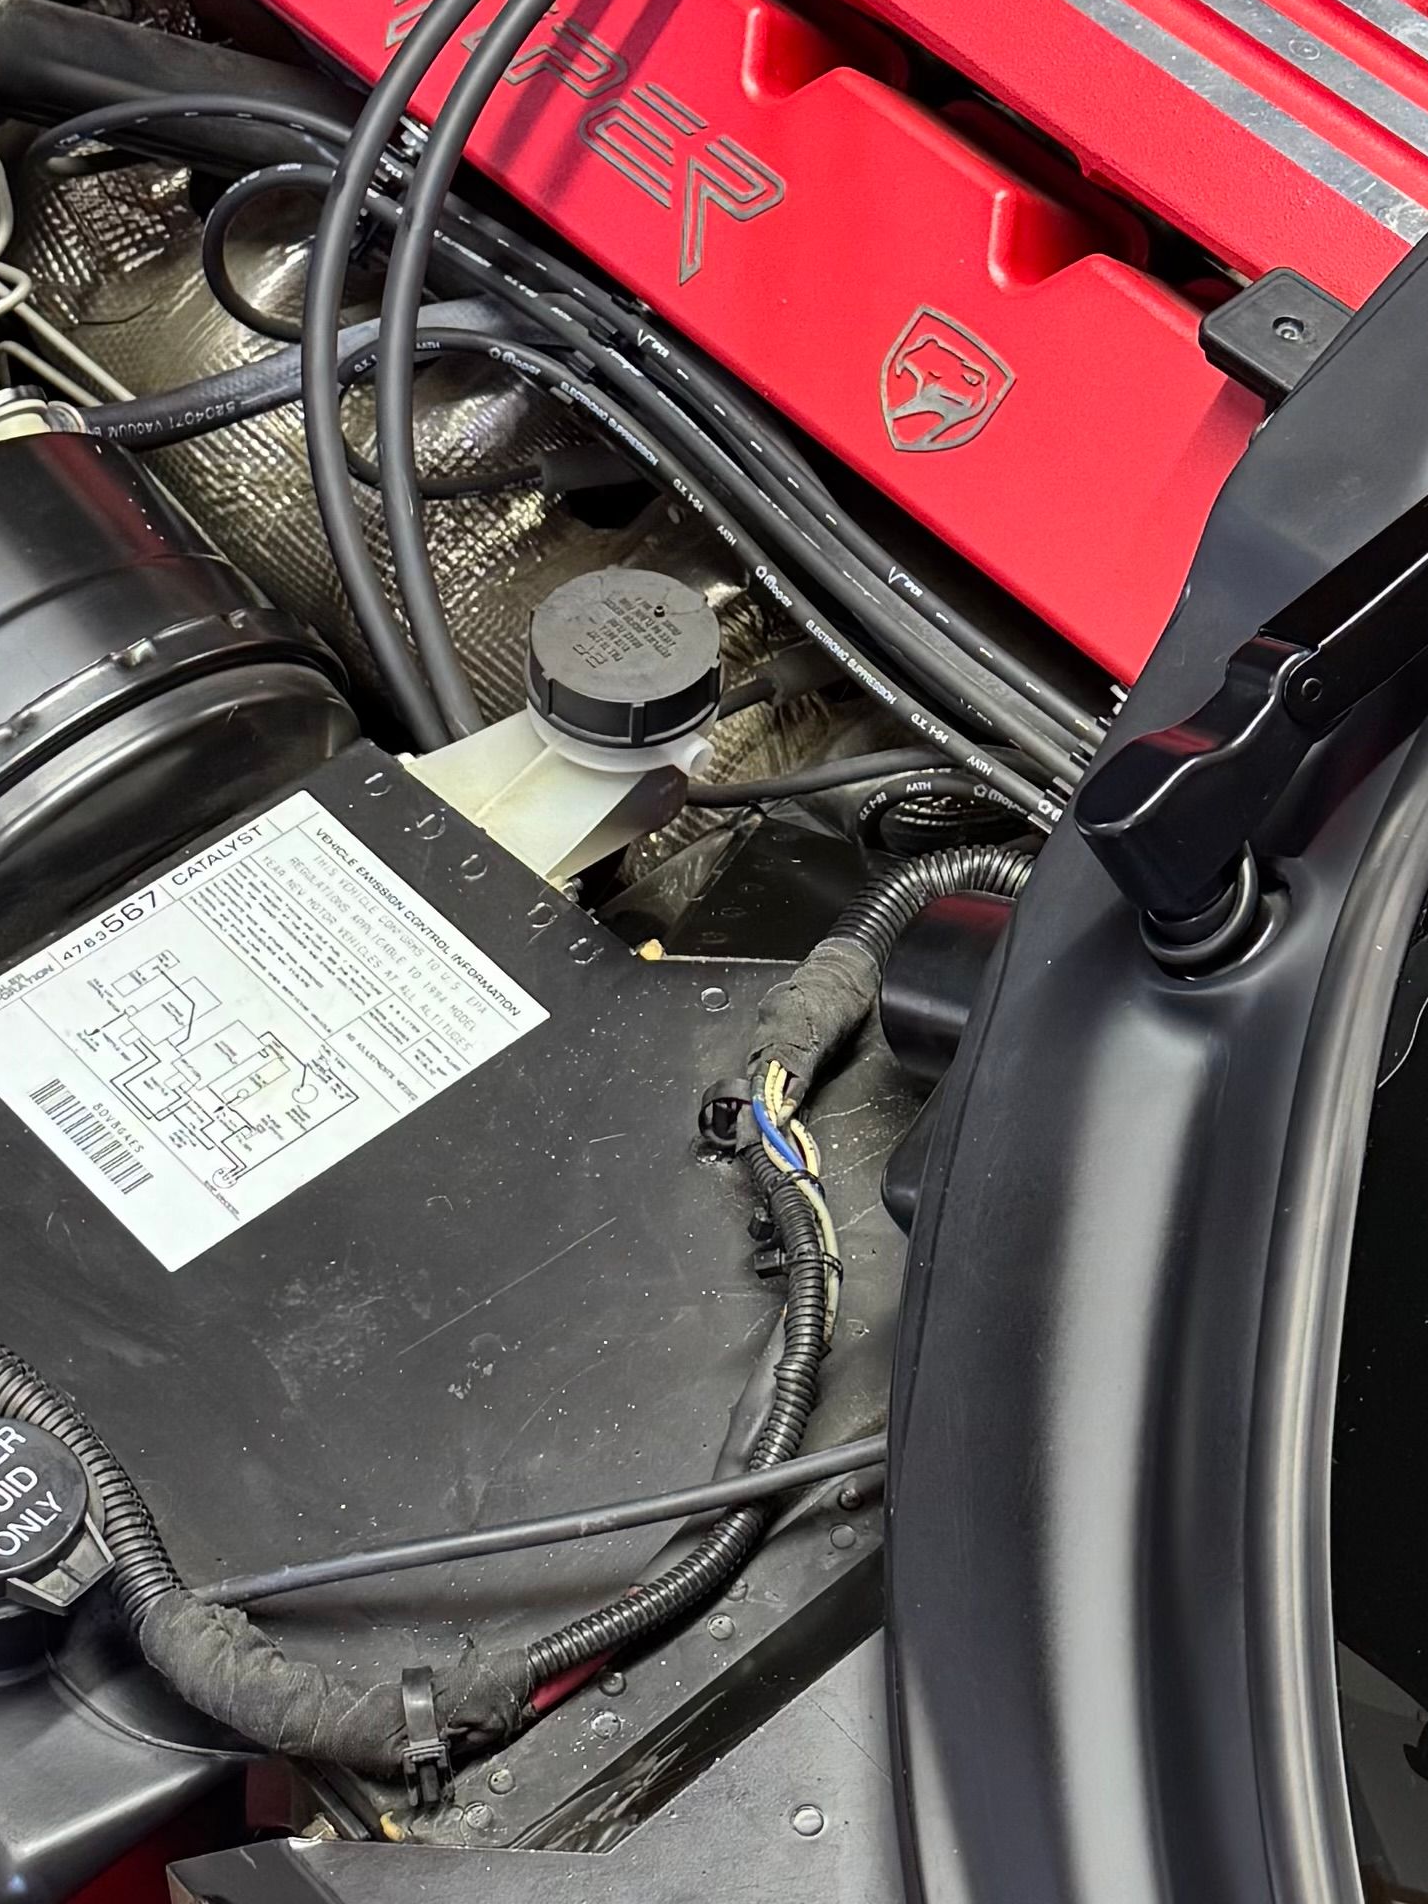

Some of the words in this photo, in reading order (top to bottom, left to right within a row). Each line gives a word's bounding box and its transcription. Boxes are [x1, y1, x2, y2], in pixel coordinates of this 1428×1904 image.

[170, 823, 266, 887] CATALYST
[313, 828, 358, 866] VEHICLE
[354, 865, 406, 911] EMISSION
[402, 910, 453, 954] CONTROL
[449, 952, 522, 1016] INFORMATION
[424, 958, 441, 971] TO
[381, 968, 399, 983] AT
[405, 965, 423, 980] TO
